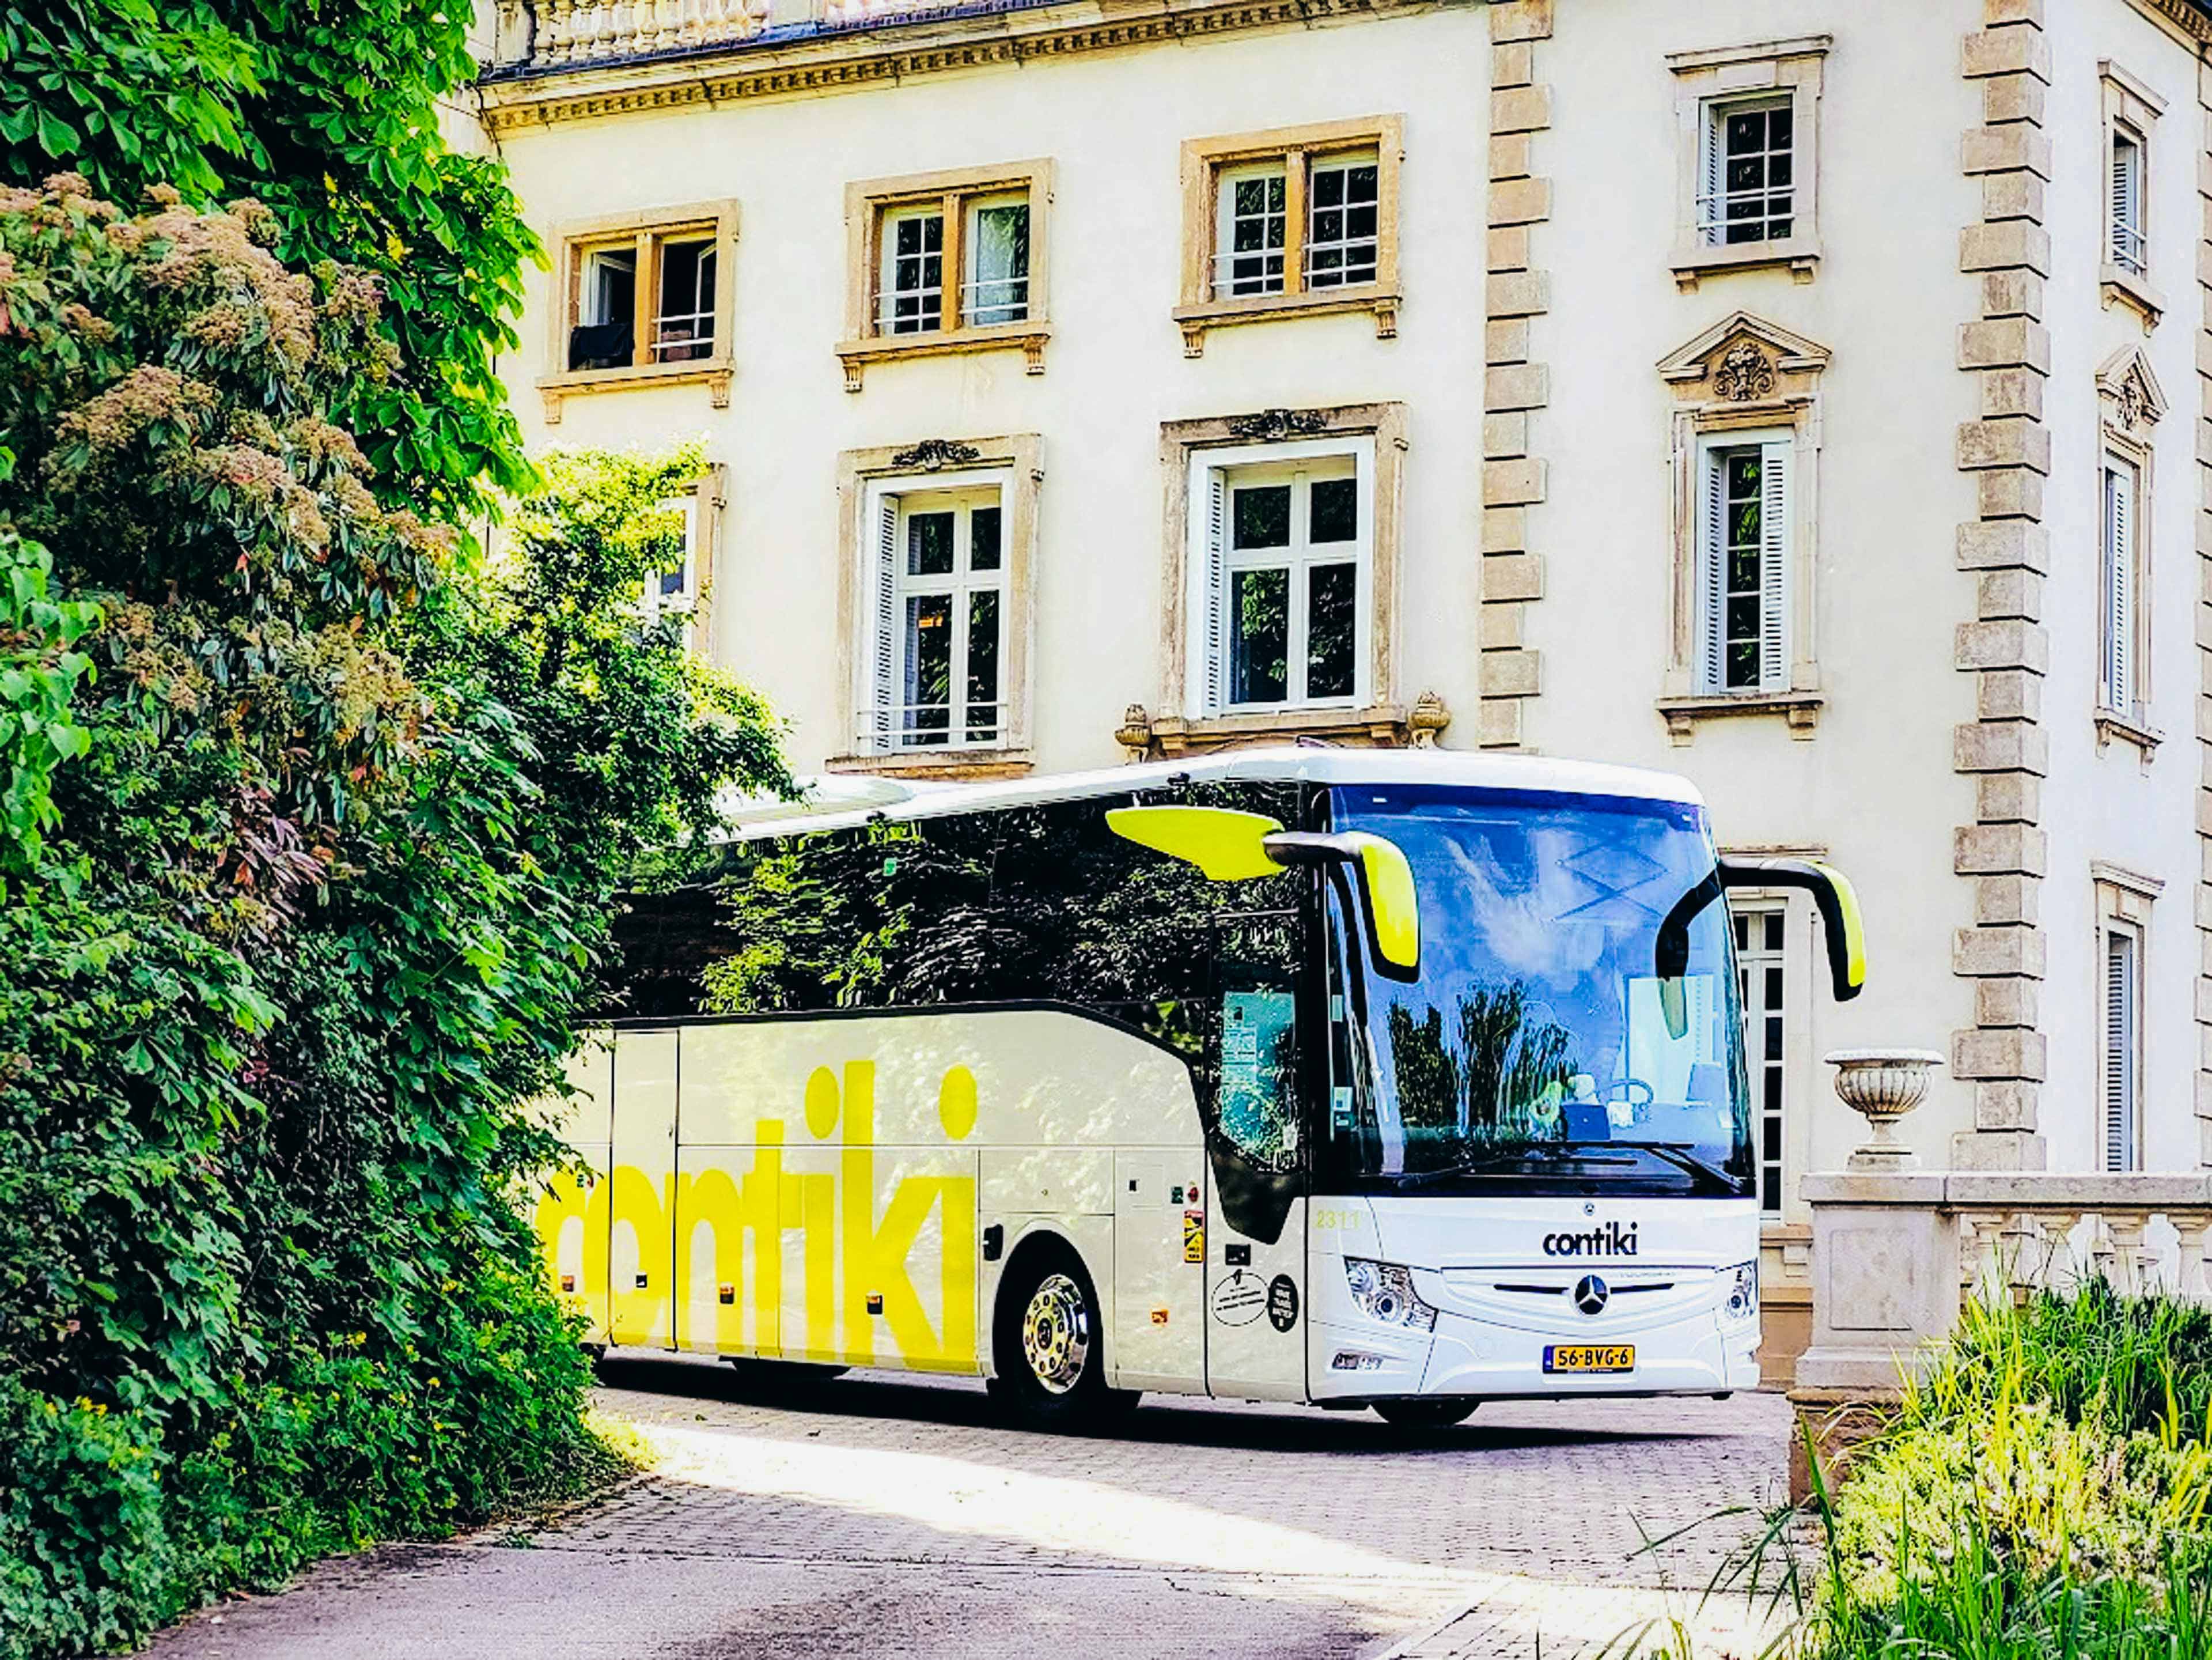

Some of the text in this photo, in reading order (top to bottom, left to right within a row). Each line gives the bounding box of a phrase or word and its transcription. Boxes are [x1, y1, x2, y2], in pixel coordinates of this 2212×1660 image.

[535, 1061, 978, 1372] contiki
[1315, 1210, 1360, 1228] 2311
[1543, 1222, 1638, 1256] contiki
[1558, 1349, 1628, 1366] 56-BVG-6
